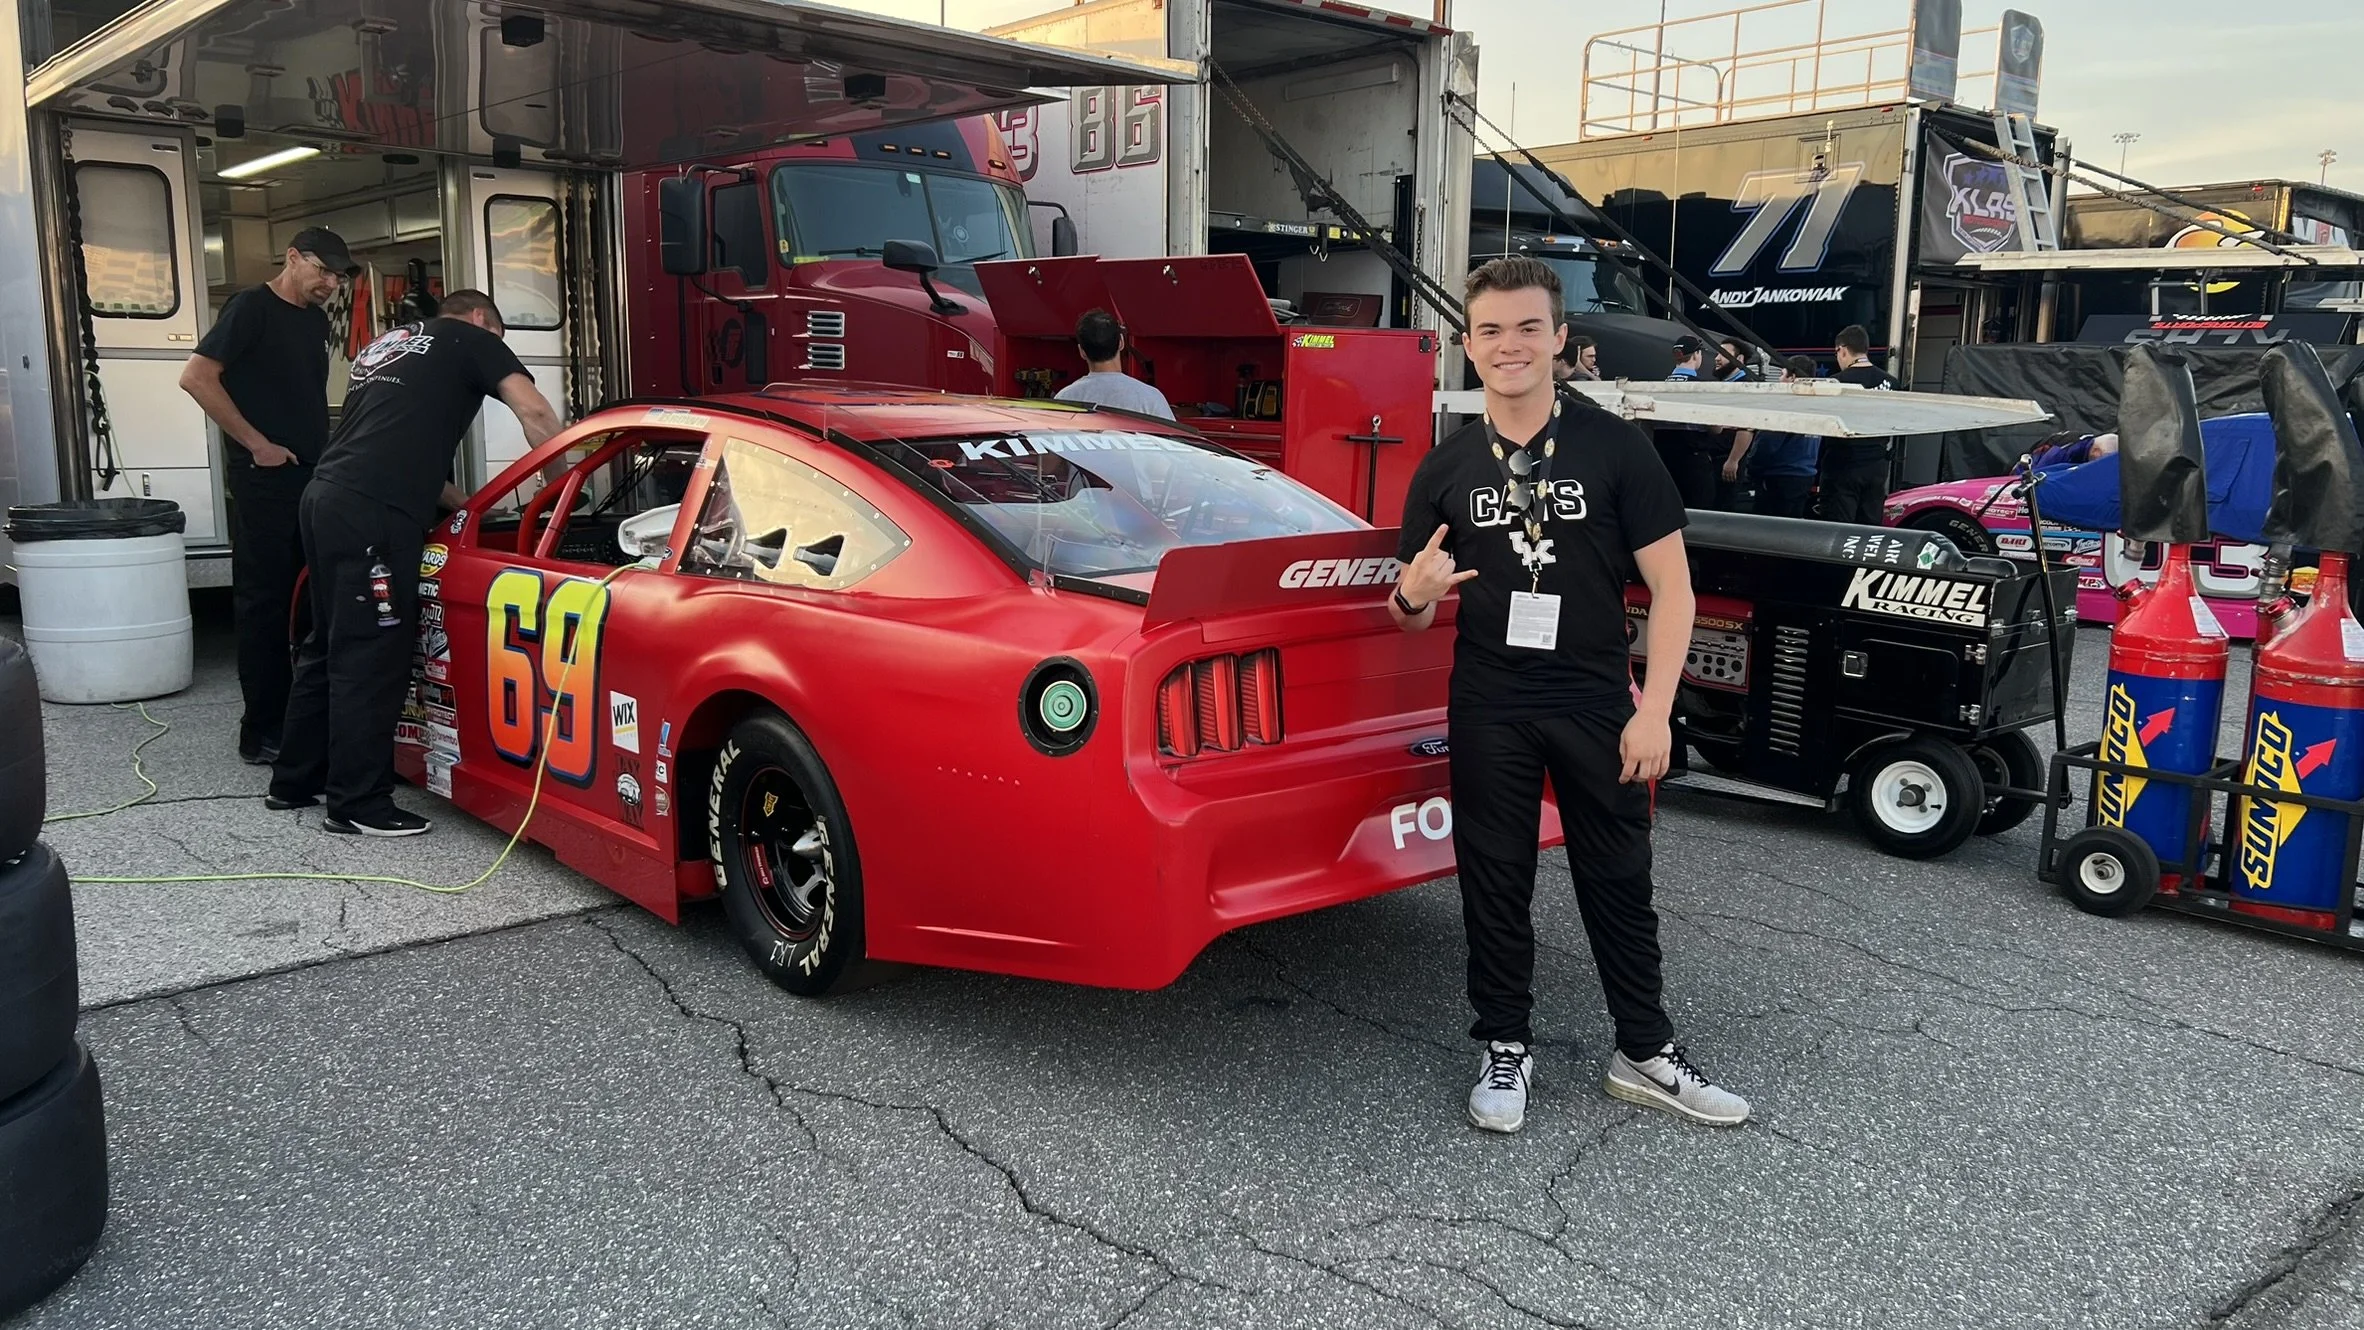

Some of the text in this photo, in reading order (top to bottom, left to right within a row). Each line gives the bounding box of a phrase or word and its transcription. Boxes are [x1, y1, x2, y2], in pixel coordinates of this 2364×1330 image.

[1071, 85, 1161, 175] 86
[1276, 222, 1309, 235] STINGER
[1709, 162, 1866, 277] 77
[1708, 286, 1851, 307] ANDY JANKOWIAK
[1301, 334, 1335, 347] KIMMEL
[957, 432, 1193, 461] KIMMEL
[1841, 567, 1987, 612] KIMMEL
[1872, 600, 1975, 624] RACING
[486, 567, 612, 790] 69
[613, 701, 635, 726] WIX
[708, 739, 741, 888] GENERAL
[800, 818, 835, 977] GENERAL
